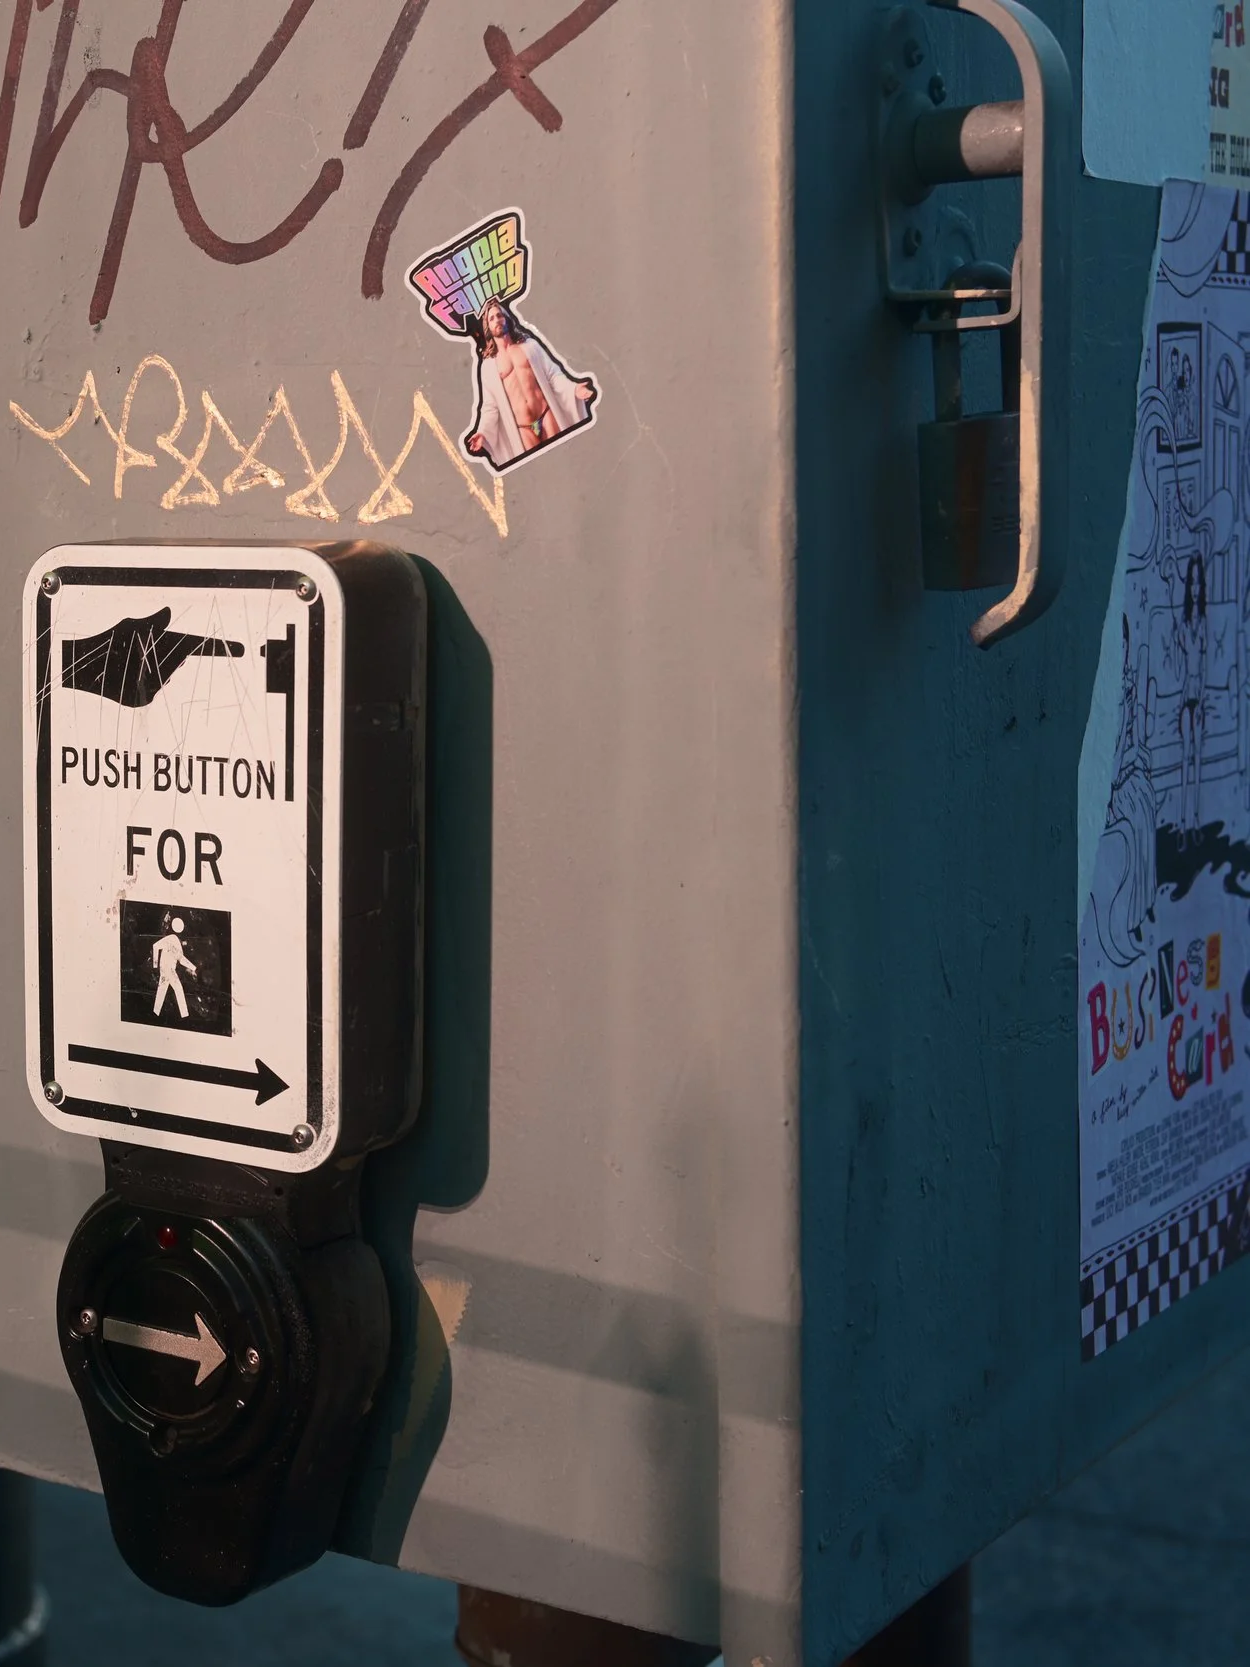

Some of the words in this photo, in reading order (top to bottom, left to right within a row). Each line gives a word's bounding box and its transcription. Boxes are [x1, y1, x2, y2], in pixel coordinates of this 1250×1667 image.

[61, 745, 142, 790] PUSH
[153, 753, 276, 800] BUTTON
[126, 825, 224, 886] FOR
